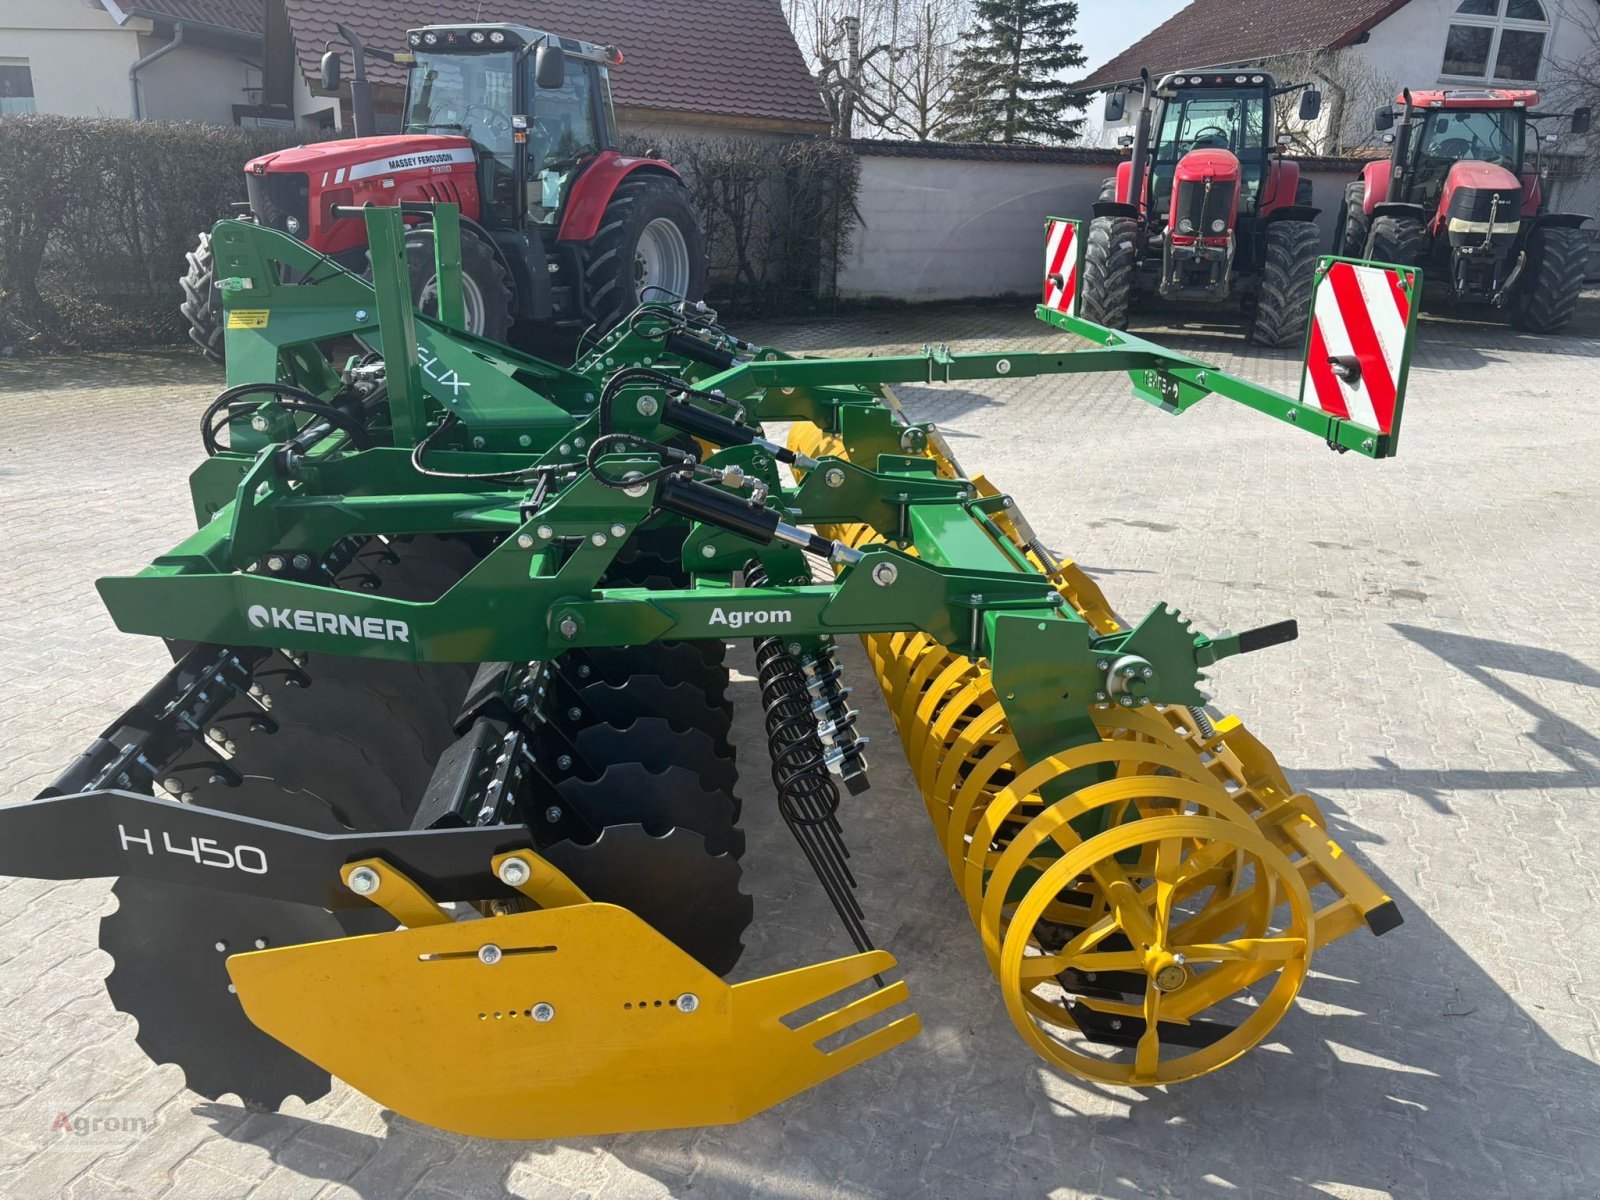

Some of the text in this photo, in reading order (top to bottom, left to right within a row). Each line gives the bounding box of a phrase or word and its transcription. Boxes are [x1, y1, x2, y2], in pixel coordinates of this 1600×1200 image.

[389, 153, 453, 169] MASSEY FERGUSON
[270, 607, 410, 643] KERNER
[708, 607, 792, 629] Agrom
[118, 824, 268, 875] H 450
